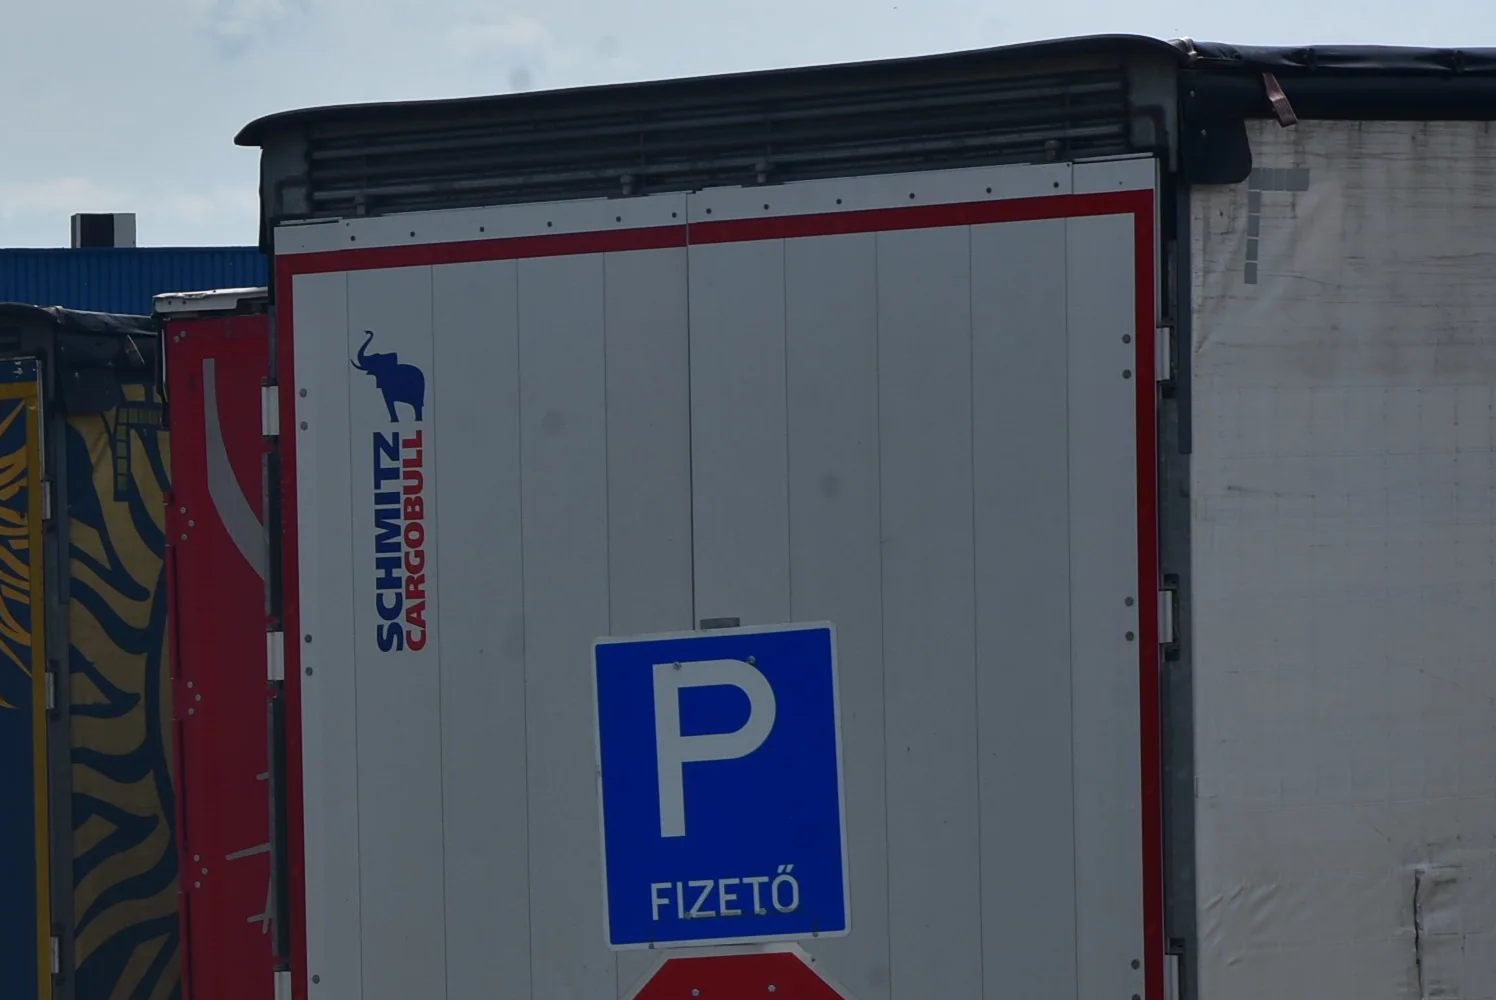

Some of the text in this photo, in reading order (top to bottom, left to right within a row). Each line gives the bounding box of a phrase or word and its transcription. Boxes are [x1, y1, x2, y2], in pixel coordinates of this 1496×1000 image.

[373, 432, 403, 652] SCHMITZ
[402, 430, 426, 651] CARGOBULL
[652, 659, 776, 837] P
[650, 865, 800, 920] FIZETŐ
